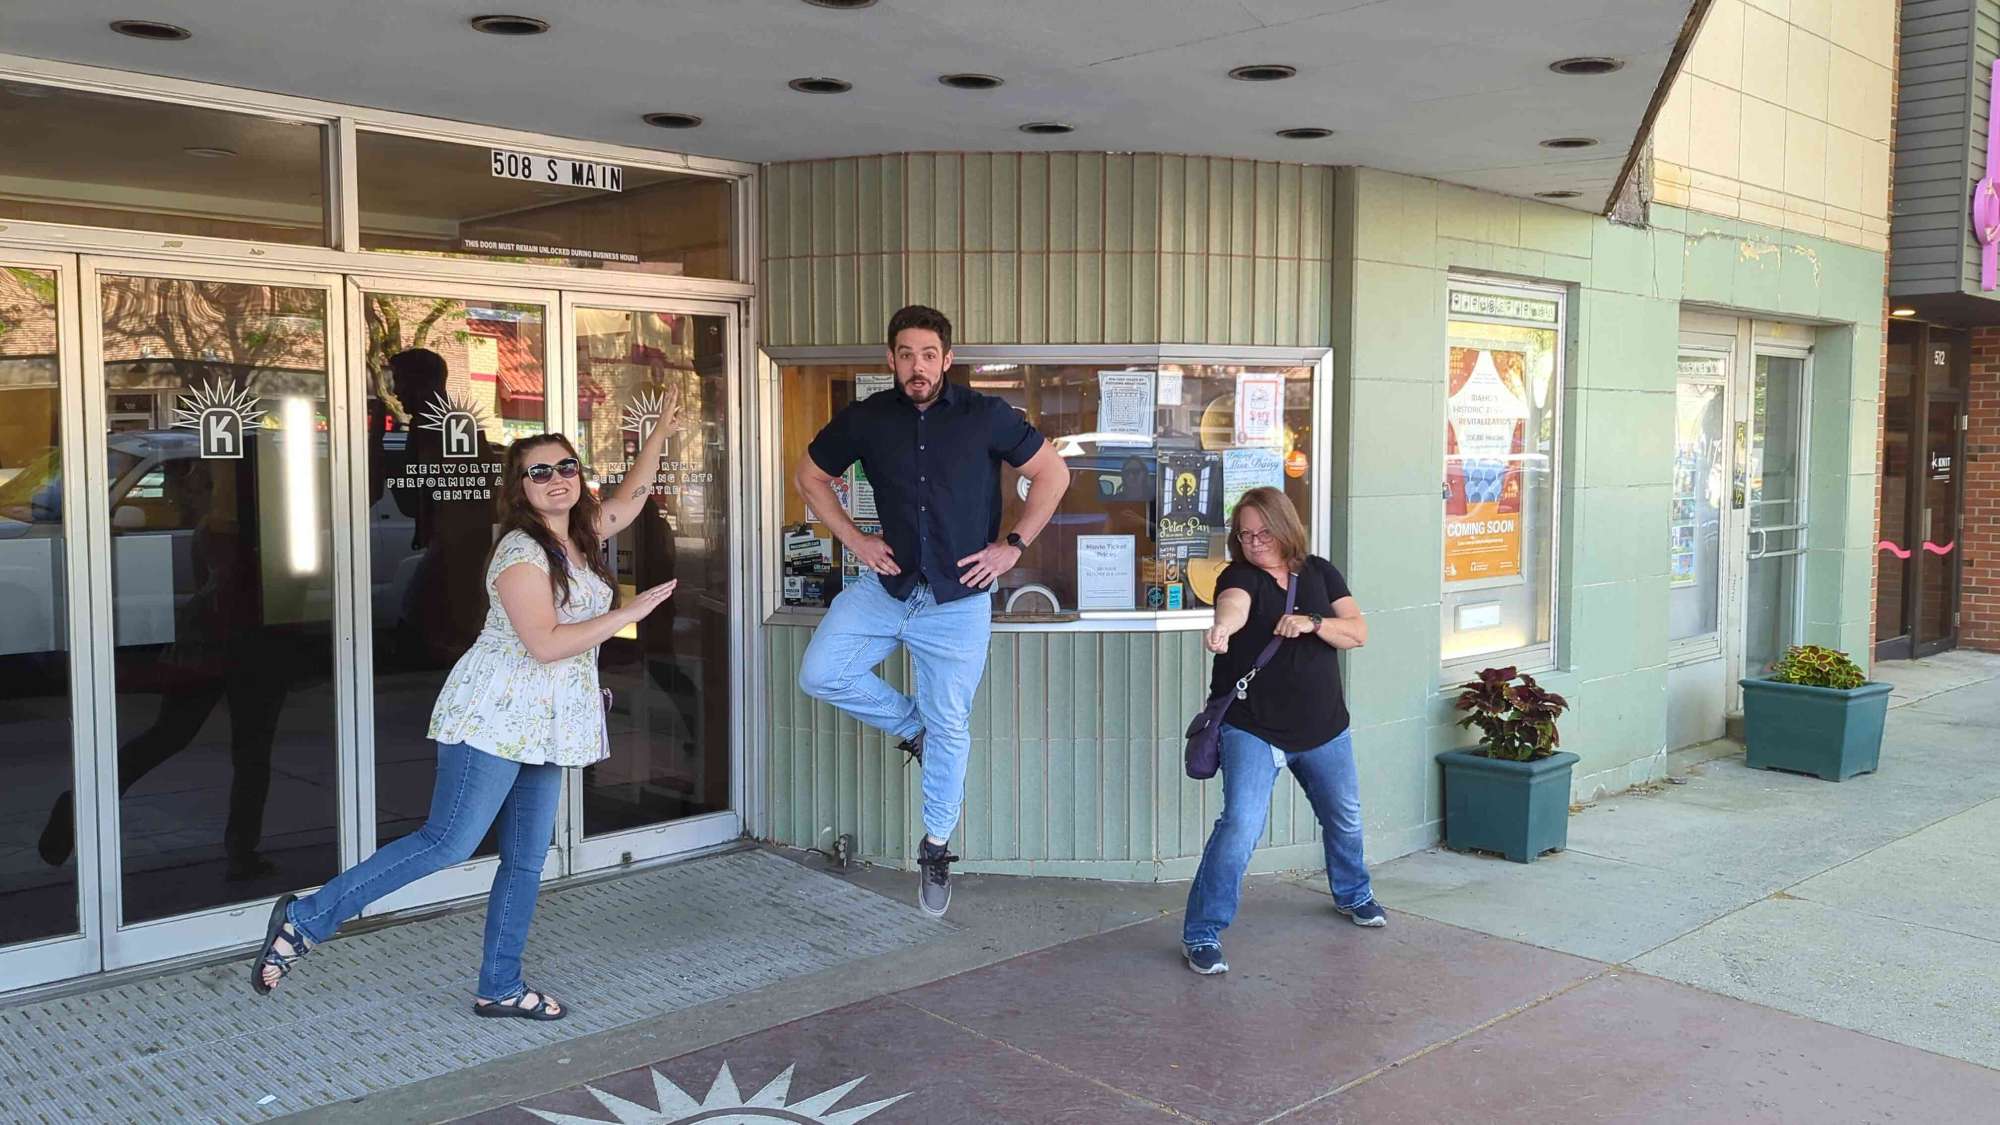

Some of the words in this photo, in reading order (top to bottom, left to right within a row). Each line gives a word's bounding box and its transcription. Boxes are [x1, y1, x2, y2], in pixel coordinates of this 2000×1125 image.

[493, 152, 532, 179] 508
[547, 159, 558, 182] S
[571, 162, 621, 190] MAIN
[464, 239, 479, 248] THIS
[480, 240, 497, 250] DOOR
[498, 242, 515, 251] MUST
[515, 243, 539, 253] REMAIN
[539, 246, 570, 256] UNLOCKED
[571, 249, 592, 258] DURING
[592, 251, 619, 260] BUSINESS
[619, 253, 638, 262] HOURS
[1934, 350, 1946, 365] 512
[209, 415, 233, 453] K
[450, 418, 470, 453] K
[406, 463, 503, 475] KENWORTH
[681, 473, 713, 483] ARTS
[386, 476, 486, 488] PERFORMING
[432, 489, 491, 501] CENTRE
[1159, 517, 1187, 538] Peter
[1187, 516, 1210, 537] Pan
[1446, 521, 1486, 537] COMING
[1486, 519, 1514, 534] SOON
